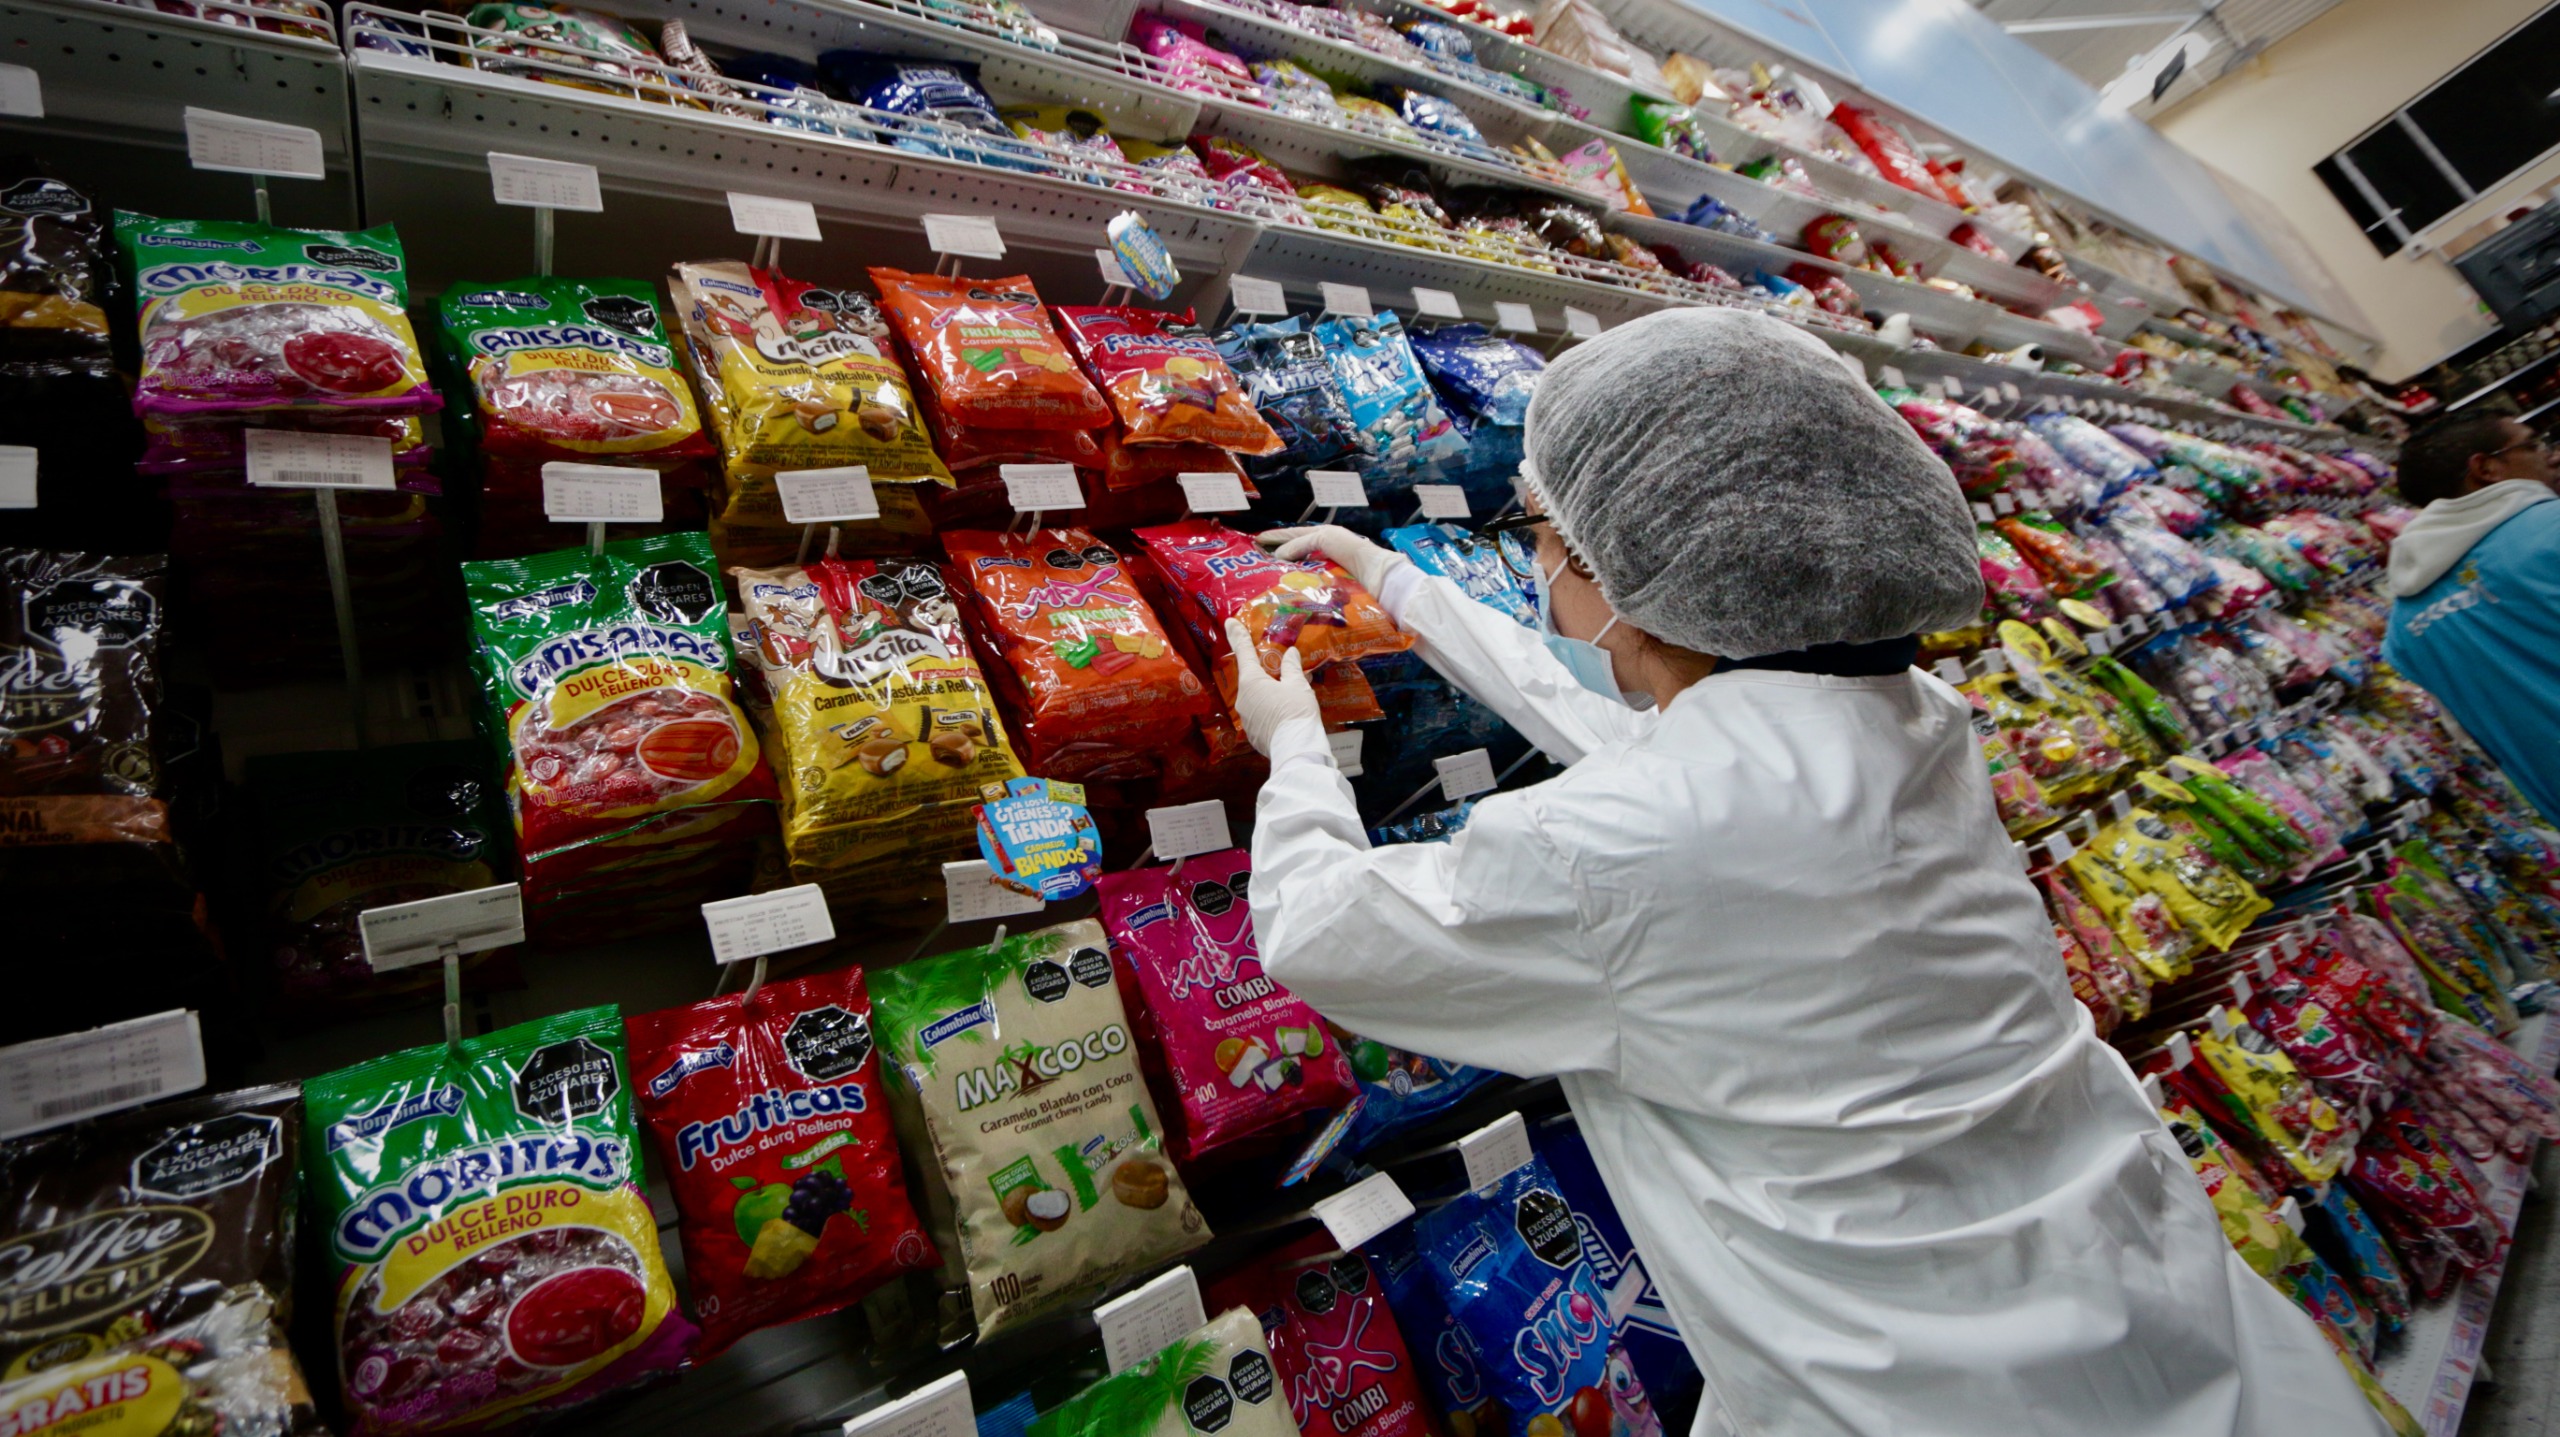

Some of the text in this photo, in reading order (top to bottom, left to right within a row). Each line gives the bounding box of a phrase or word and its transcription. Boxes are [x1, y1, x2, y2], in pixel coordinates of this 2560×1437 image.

[146, 263, 400, 307] MORITAS
[240, 291, 319, 303] RELLENO
[288, 286, 354, 303] DURO
[702, 278, 749, 294] Colombina
[479, 326, 667, 366] ANISADAS
[958, 327, 1042, 340] FRUTACIDAS
[1103, 332, 1218, 355] Fruticas
[523, 351, 582, 363] DULCE
[553, 358, 613, 373] RELLENO
[1245, 367, 1332, 409] Xtime
[41, 609, 144, 628] AZÚCARES
[519, 625, 724, 694] ANISADAS
[837, 634, 928, 674] nucita
[564, 666, 628, 699] DULCE
[599, 674, 665, 700] RELLENO
[814, 691, 876, 712] Caramelo
[549, 784, 598, 804] Unidades
[1002, 818, 1074, 846] TIENDA
[1013, 847, 1088, 878] BLANDOS
[1128, 906, 1168, 929] Colombina
[1213, 974, 1277, 1010] COMBI
[925, 1010, 981, 1047] Colombina
[1204, 1006, 1263, 1033] Caramelo
[1261, 1007, 1294, 1026] Candy
[796, 1028, 839, 1050] EXCESO
[528, 1060, 602, 1091] EXCESO EN
[955, 1023, 1128, 1112] MAXCOCO
[526, 1071, 610, 1107] AZÚCARES
[979, 1072, 1134, 1135] Caramelo Blando con Coco
[1194, 1081, 1218, 1105] 100
[675, 1081, 868, 1173] Fruticas
[1014, 1091, 1113, 1135] Coconut chewy candy
[150, 1137, 268, 1182] AZÚCARES
[158, 1127, 262, 1169] EXCESO EN
[710, 1116, 854, 1174] Dulce duro Relleno
[789, 1131, 850, 1170] surtidas
[341, 1136, 624, 1252] MORITAS
[405, 1187, 582, 1258] DULCE DURO
[453, 1211, 544, 1253] RELLENO
[1525, 1207, 1565, 1238] EXCESO EN
[1531, 1217, 1574, 1250] AZÚCARES
[1453, 1243, 1487, 1278] Colombina
[989, 1272, 1023, 1308] 100
[1231, 1357, 1264, 1380] EXCESO EN
[1237, 1365, 1267, 1388] GRASAS
[1189, 1387, 1224, 1412] EXCESO EN
[1236, 1370, 1273, 1400] SATURADAS
[1192, 1395, 1230, 1423] AZÚCARES
[1331, 1382, 1391, 1435] COMBI
[1378, 1399, 1416, 1430] Blando
